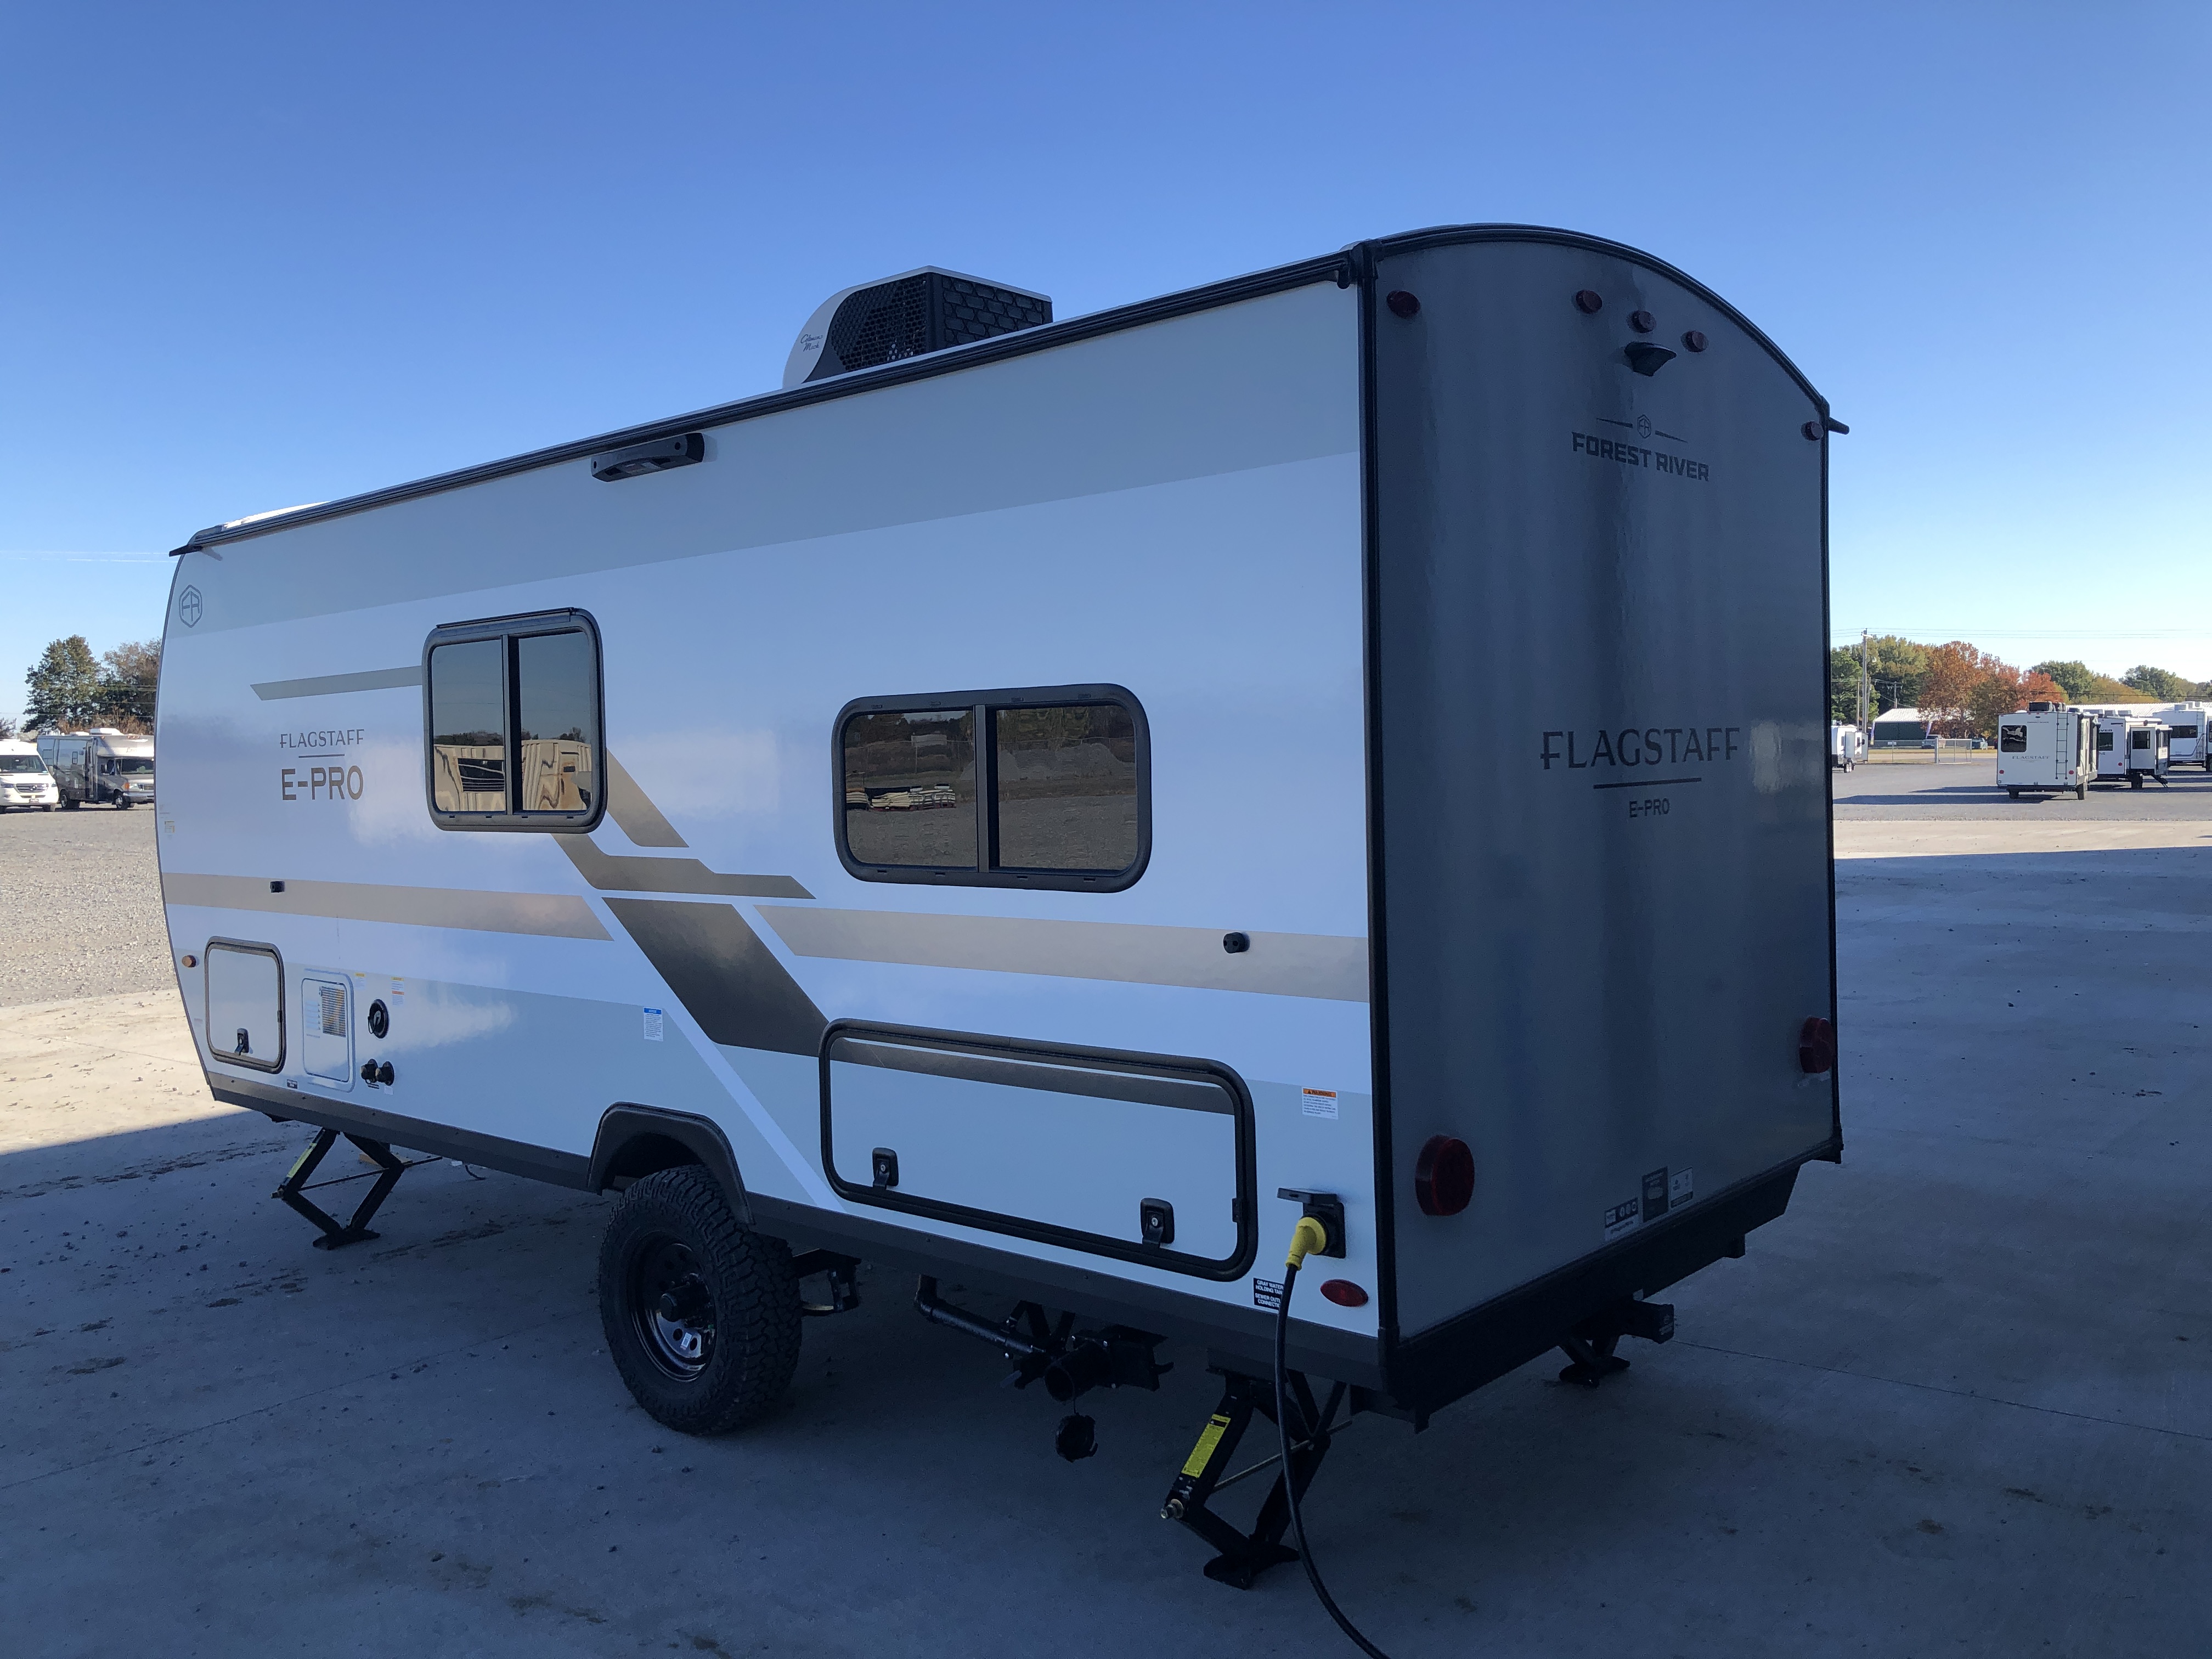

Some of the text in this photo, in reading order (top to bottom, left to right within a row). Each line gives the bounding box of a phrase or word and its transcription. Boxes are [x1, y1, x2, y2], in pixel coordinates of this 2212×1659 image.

[1571, 431, 1709, 482] FOREST RIVER
[280, 729, 365, 748] FLAGSTAFF
[1539, 727, 1740, 770] FLAGSTAFF
[281, 765, 364, 800] E-PRO
[1629, 798, 1670, 818] E-PRO
[1255, 1284, 1274, 1293] HOLDING
[1255, 1293, 1270, 1301] SEWER
[1257, 1299, 1280, 1308] CONNECTIO
